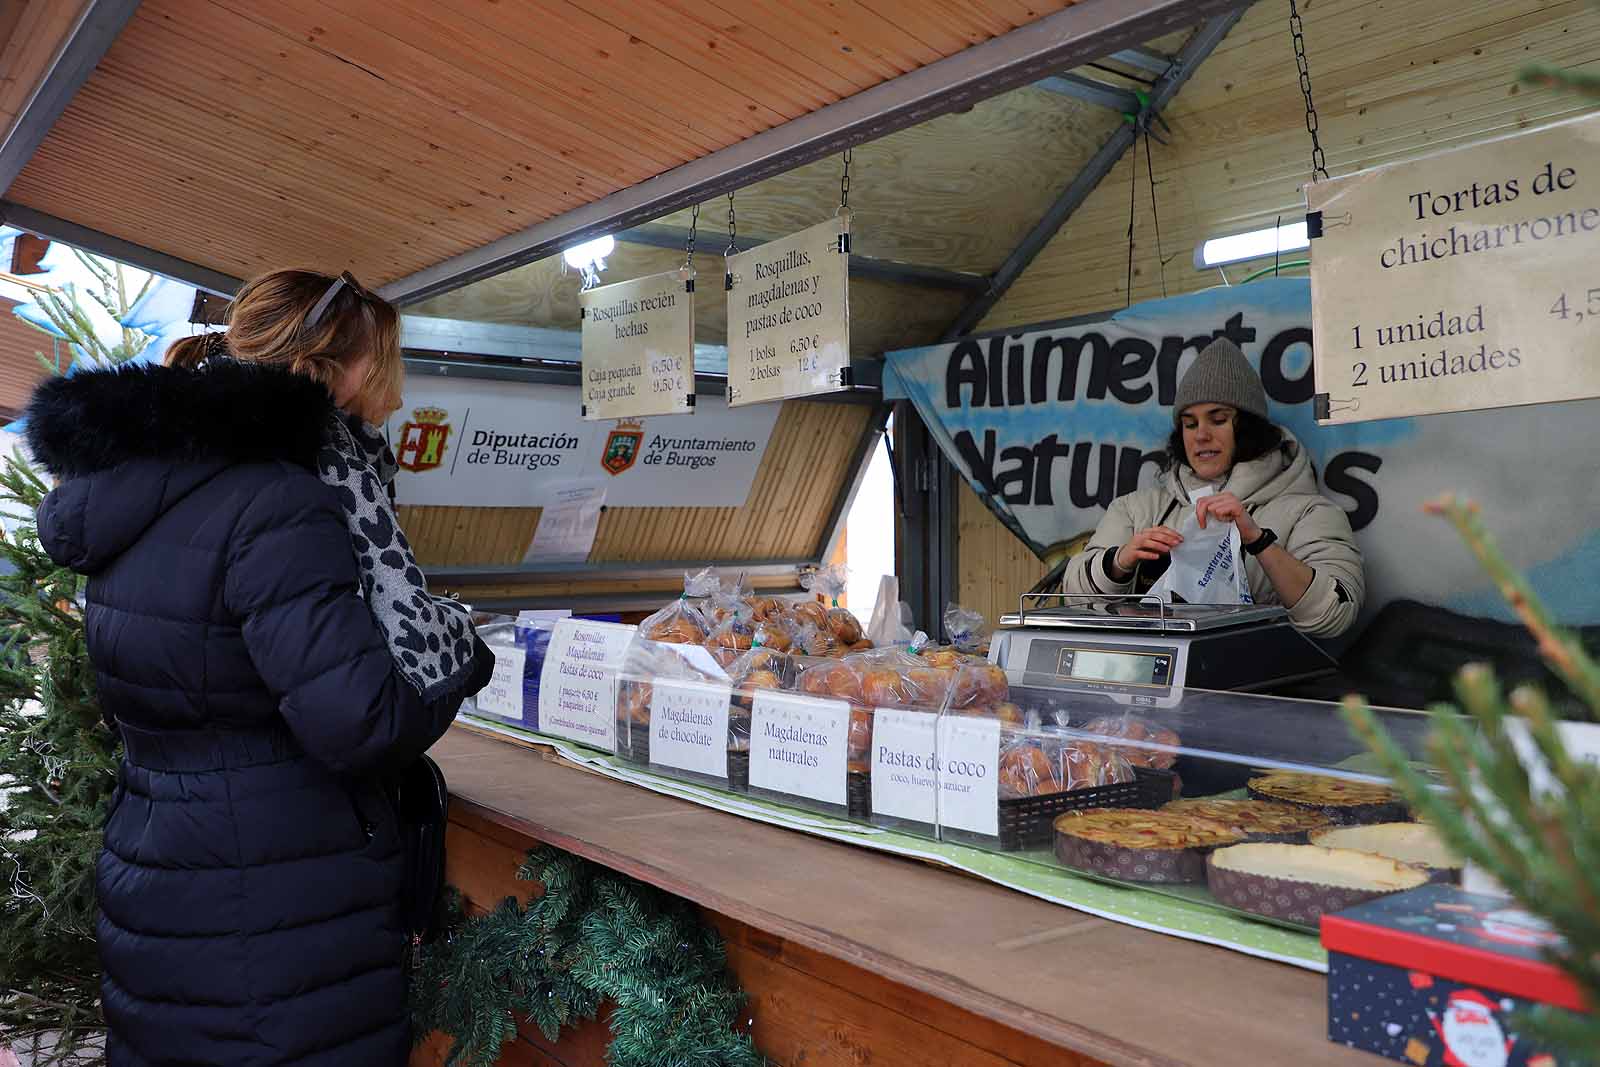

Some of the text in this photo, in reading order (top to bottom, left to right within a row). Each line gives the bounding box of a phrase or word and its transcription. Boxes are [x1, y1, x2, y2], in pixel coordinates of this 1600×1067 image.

[1409, 161, 1577, 220] Tortas de
[1380, 207, 1600, 269] chicharrone
[748, 275, 820, 309] magdalenas y
[592, 291, 676, 322] Rosquillas recién
[615, 320, 649, 339] hechas
[746, 302, 822, 338] pastas de coco
[1352, 288, 1600, 349] 1 unidad 4,5
[756, 346, 776, 362] bolsa
[813, 334, 819, 349] €
[750, 369, 756, 380] 2
[757, 365, 781, 380] bolsas
[798, 357, 809, 372] 12
[946, 312, 1314, 408] Alimento
[1351, 345, 1521, 387] 2 unidades
[607, 382, 635, 402] grande
[471, 429, 578, 450] Diputación
[648, 434, 756, 451] Ayuntamiento
[467, 449, 560, 470] de Burgos
[643, 450, 716, 470] de Burgos
[566, 646, 605, 662] Magdalenas
[560, 662, 604, 680] Pastas de coco
[662, 706, 713, 726] Magdalenas
[658, 725, 712, 746] de chocolate
[764, 721, 827, 746] Magdalenas
[768, 747, 818, 768] naturales
[879, 746, 985, 778] Pastas de coco
